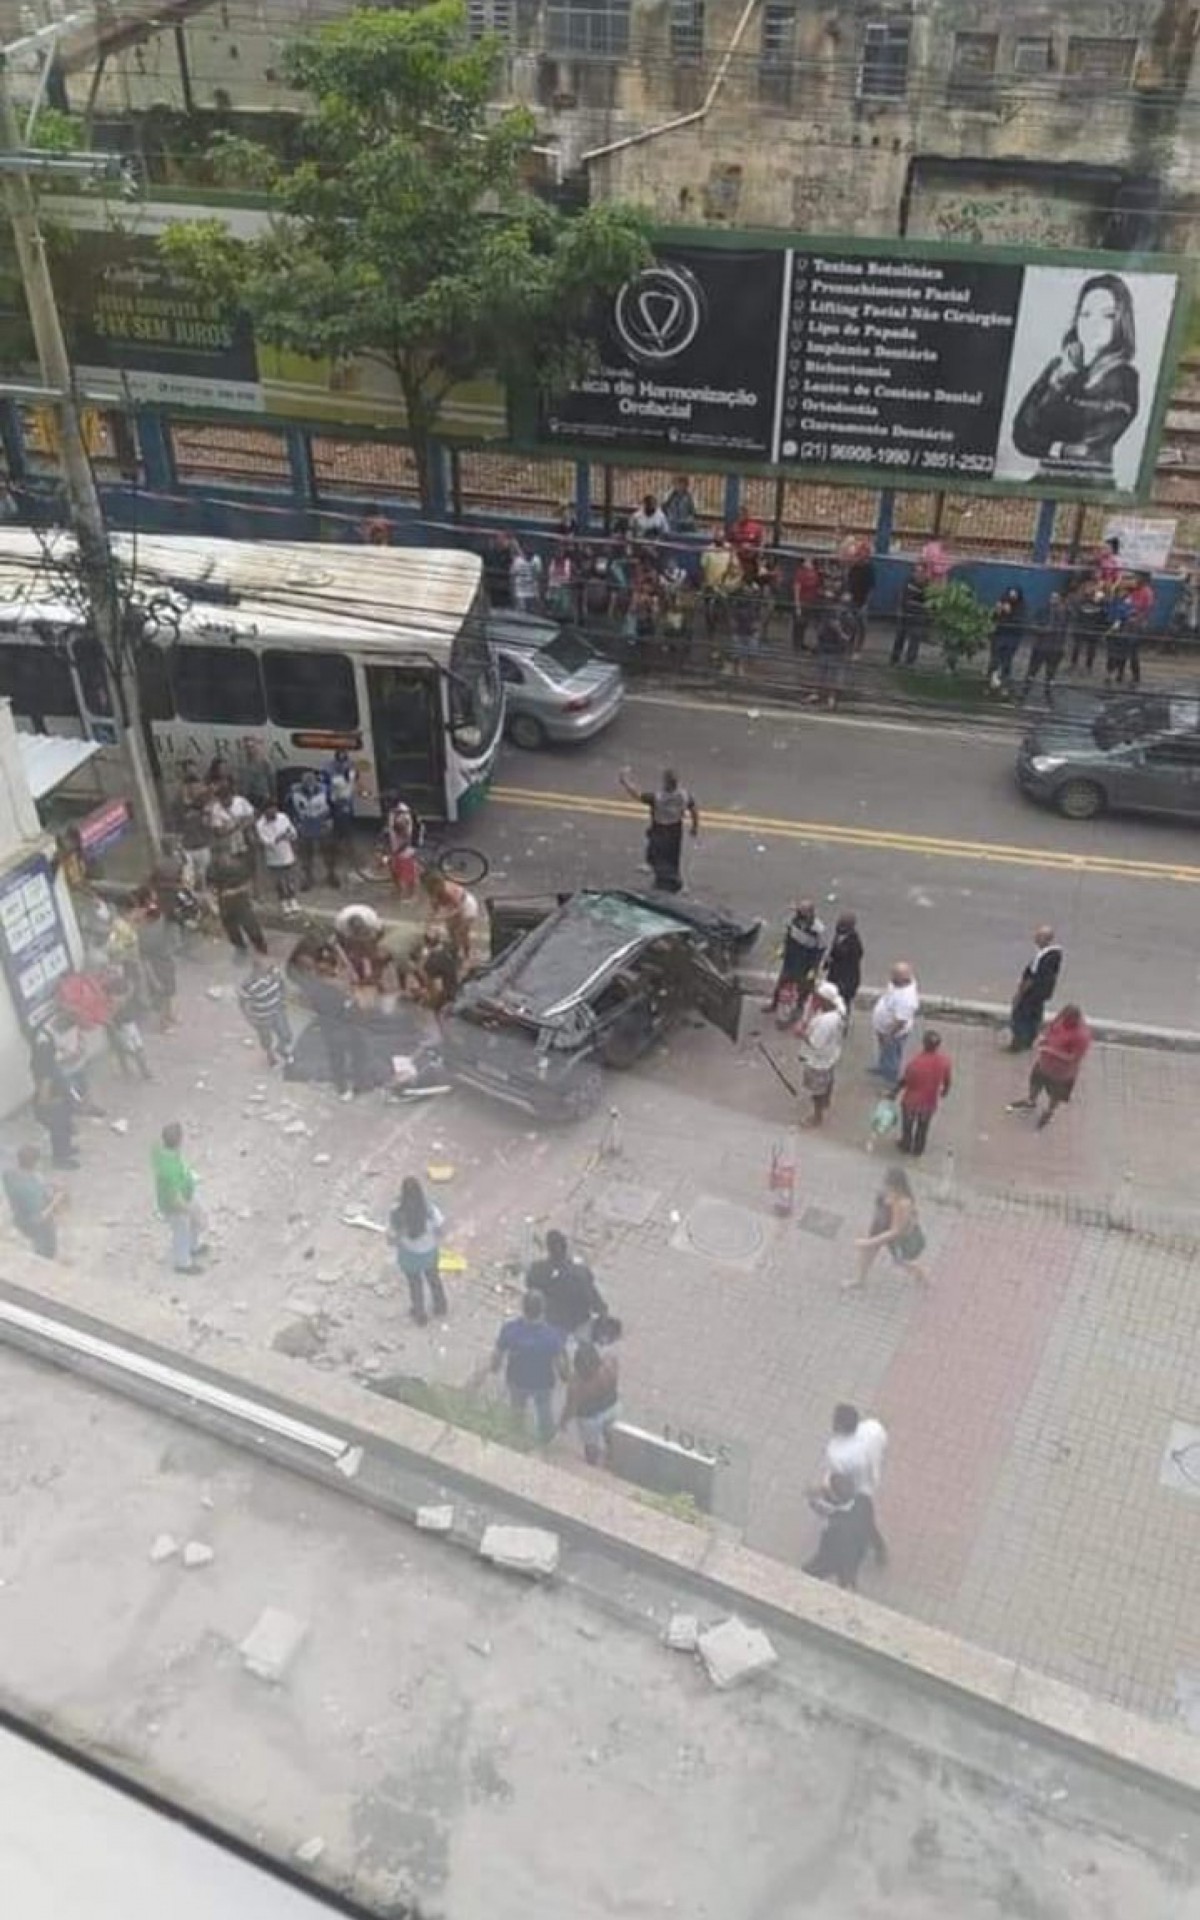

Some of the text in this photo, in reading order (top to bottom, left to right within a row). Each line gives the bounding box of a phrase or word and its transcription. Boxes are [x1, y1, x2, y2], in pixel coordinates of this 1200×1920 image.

[925, 287, 970, 302] Facial
[810, 301, 859, 319] Lifting
[863, 303, 906, 319] Facial
[864, 323, 917, 340] Papada
[614, 380, 635, 395] de
[640, 381, 757, 409] Harmonização
[934, 389, 983, 405] Dental
[619, 398, 691, 420] Orofacial
